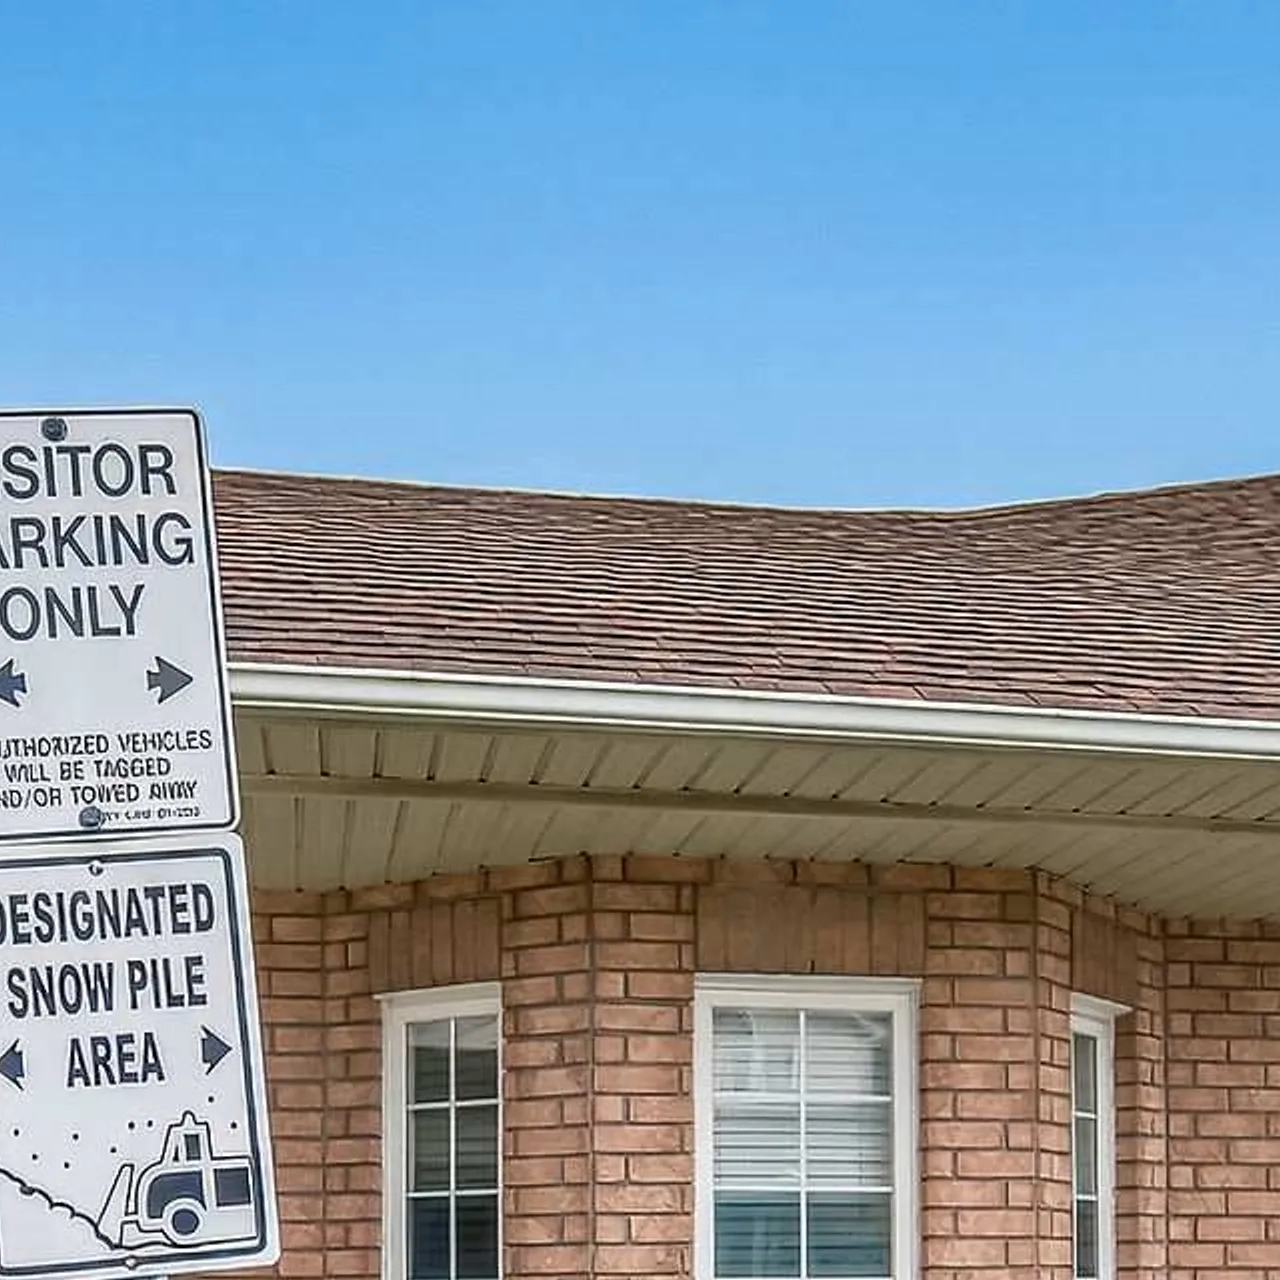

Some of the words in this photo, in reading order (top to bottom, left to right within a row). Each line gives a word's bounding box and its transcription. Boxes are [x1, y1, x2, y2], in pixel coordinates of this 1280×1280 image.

[117, 729, 212, 753] VEHICLES
[4, 763, 51, 783] WILL
[60, 760, 85, 781] BE
[94, 757, 171, 779] TAGGED
[70, 783, 140, 805] TOWED
[149, 780, 198, 800] AWAY
[7, 960, 115, 1019] SNOW
[127, 955, 208, 1010] PILE
[66, 1031, 165, 1088] AREA
